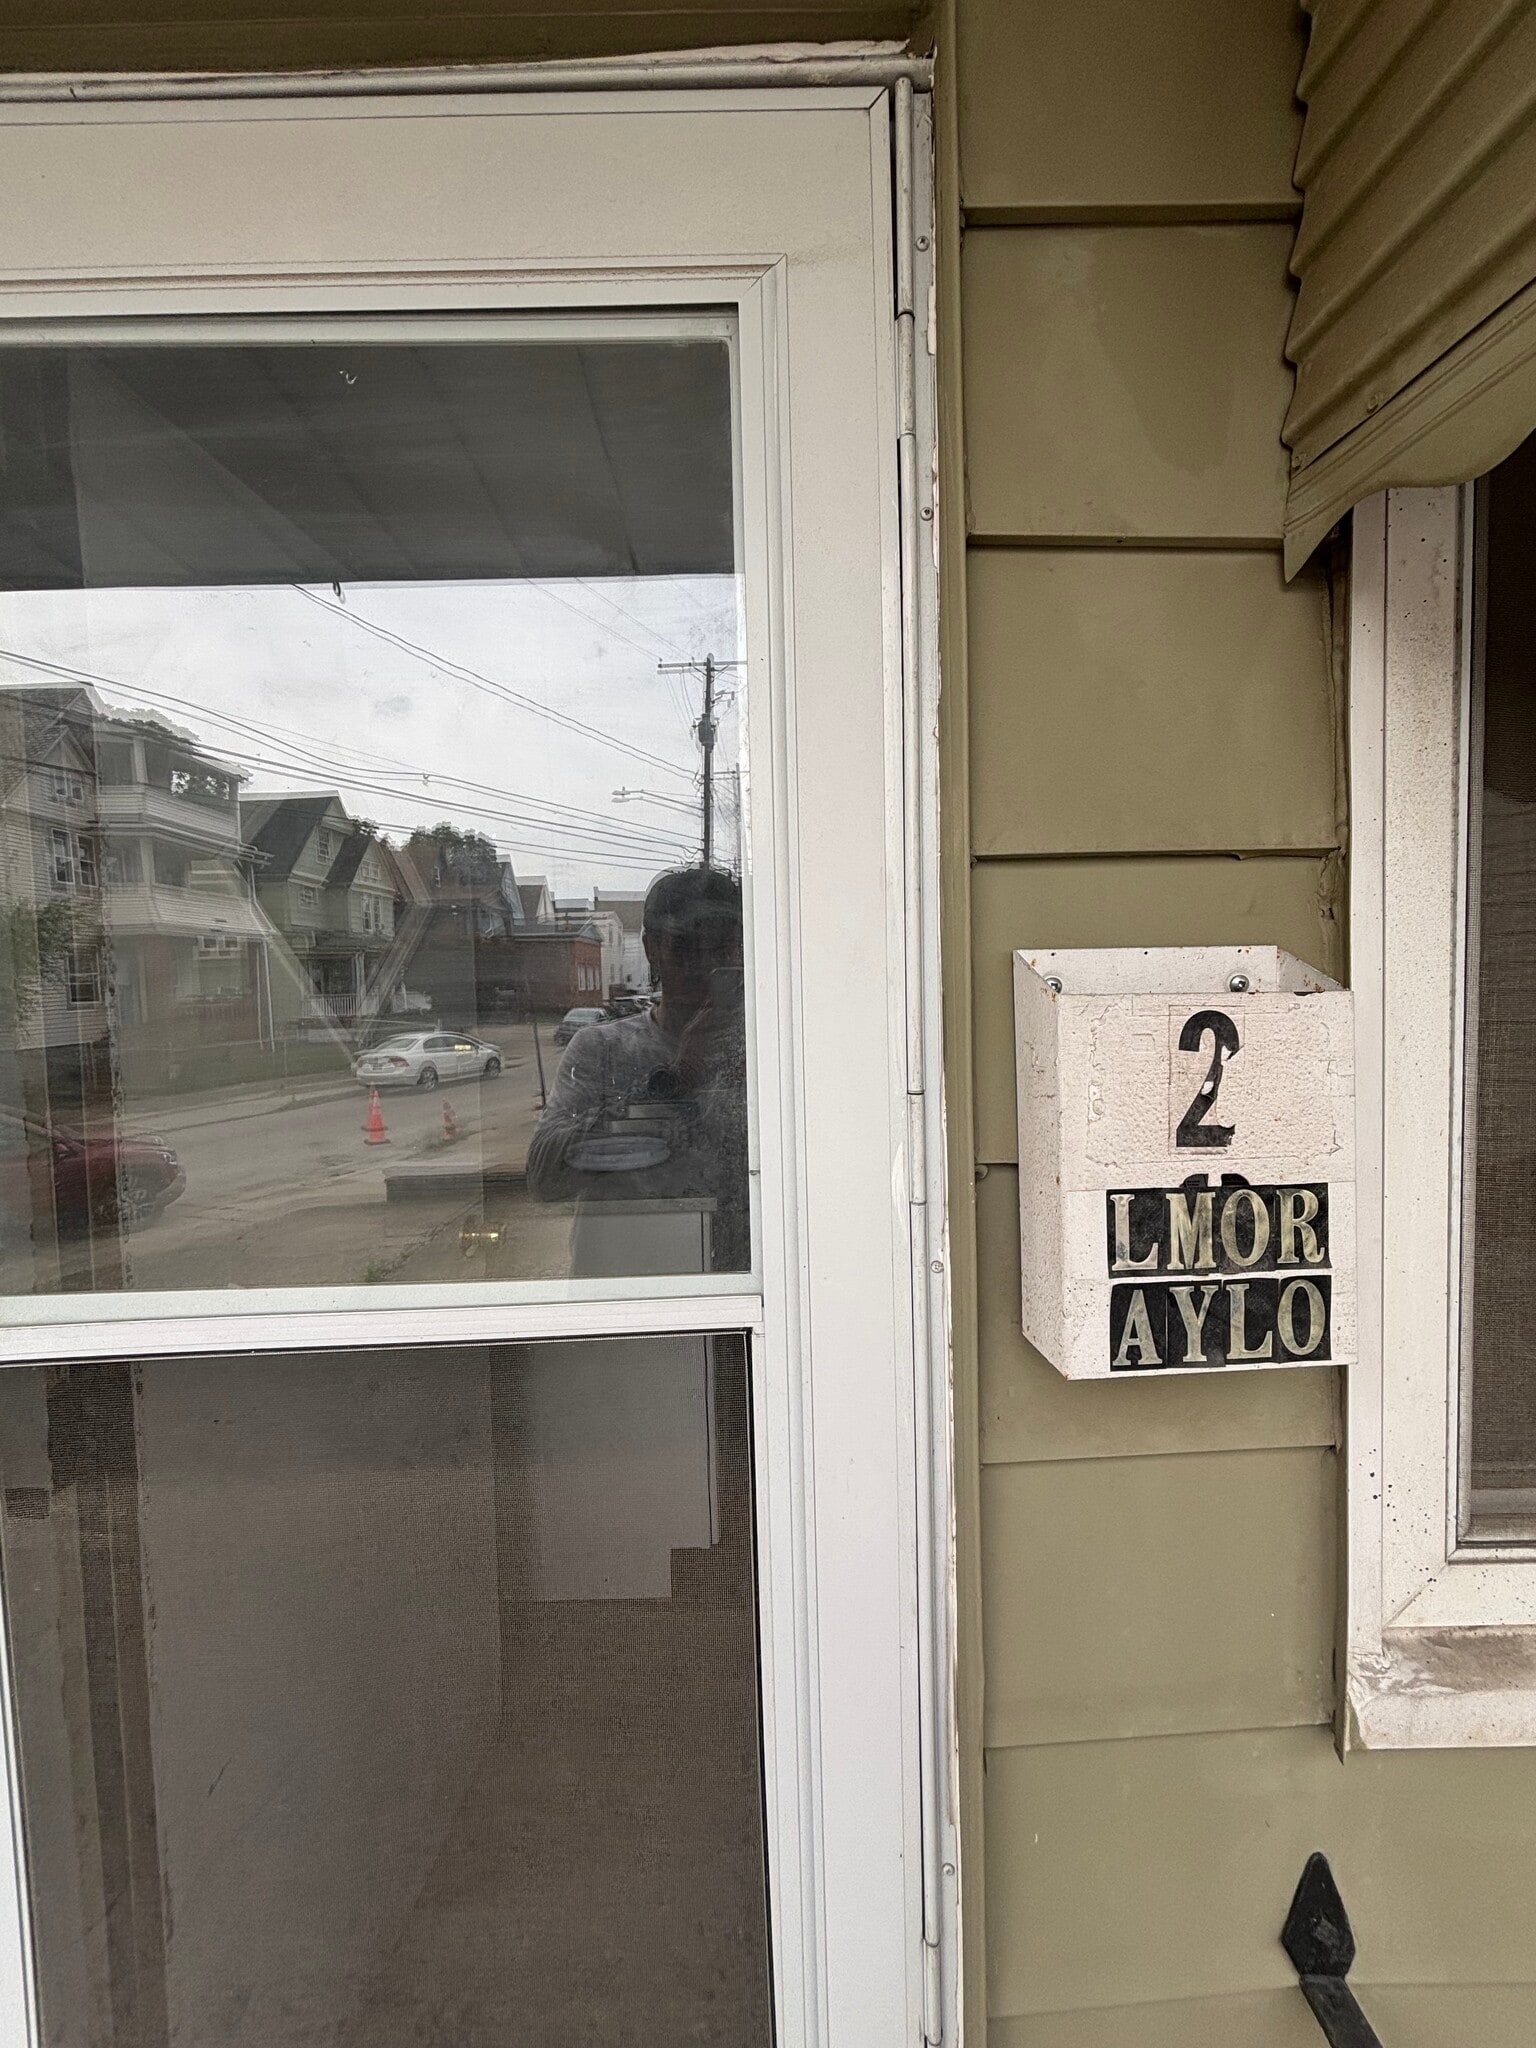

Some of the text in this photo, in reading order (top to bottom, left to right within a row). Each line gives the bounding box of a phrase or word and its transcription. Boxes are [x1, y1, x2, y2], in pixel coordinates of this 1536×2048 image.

[1176, 1009, 1240, 1147] 2
[1111, 1189, 1325, 1271] LMOR
[1112, 1279, 1326, 1367] AYLO
